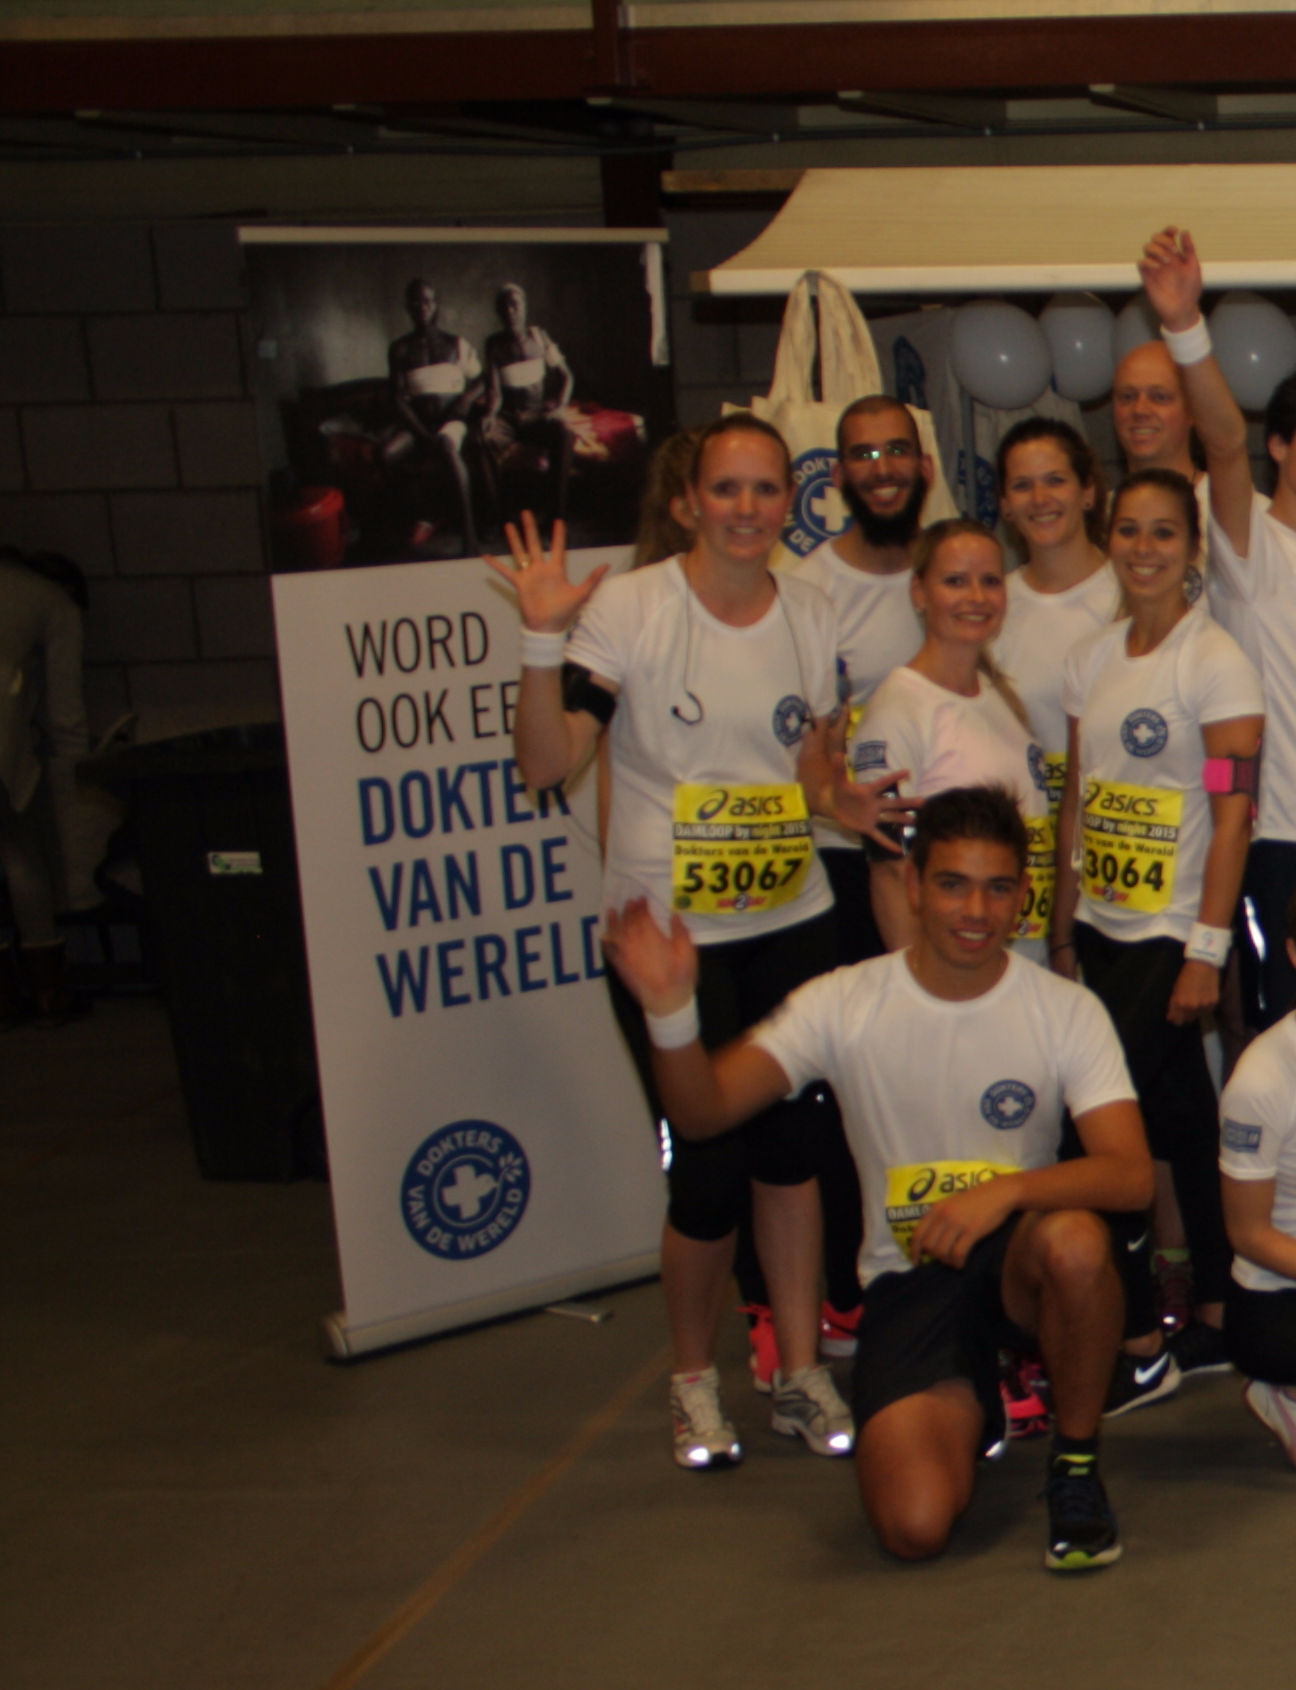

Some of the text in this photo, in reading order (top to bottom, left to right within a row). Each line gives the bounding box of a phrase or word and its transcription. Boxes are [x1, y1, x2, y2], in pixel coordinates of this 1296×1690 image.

[792, 457, 839, 486] DOKT
[345, 612, 489, 678] WORD
[356, 681, 518, 753] OOK EE
[729, 795, 784, 817] asics
[1100, 792, 1158, 817] asics
[1149, 826, 1176, 838] 2015
[367, 836, 573, 932] VAN DE
[683, 857, 804, 893] 53067
[1086, 849, 1164, 892] 3064
[375, 914, 609, 1018] WERELD
[416, 1129, 503, 1177] DOKTERS
[940, 1168, 996, 1194] asic
[407, 1184, 523, 1251] VAN DE WERELD
[888, 1204, 931, 1221] DAMLO
